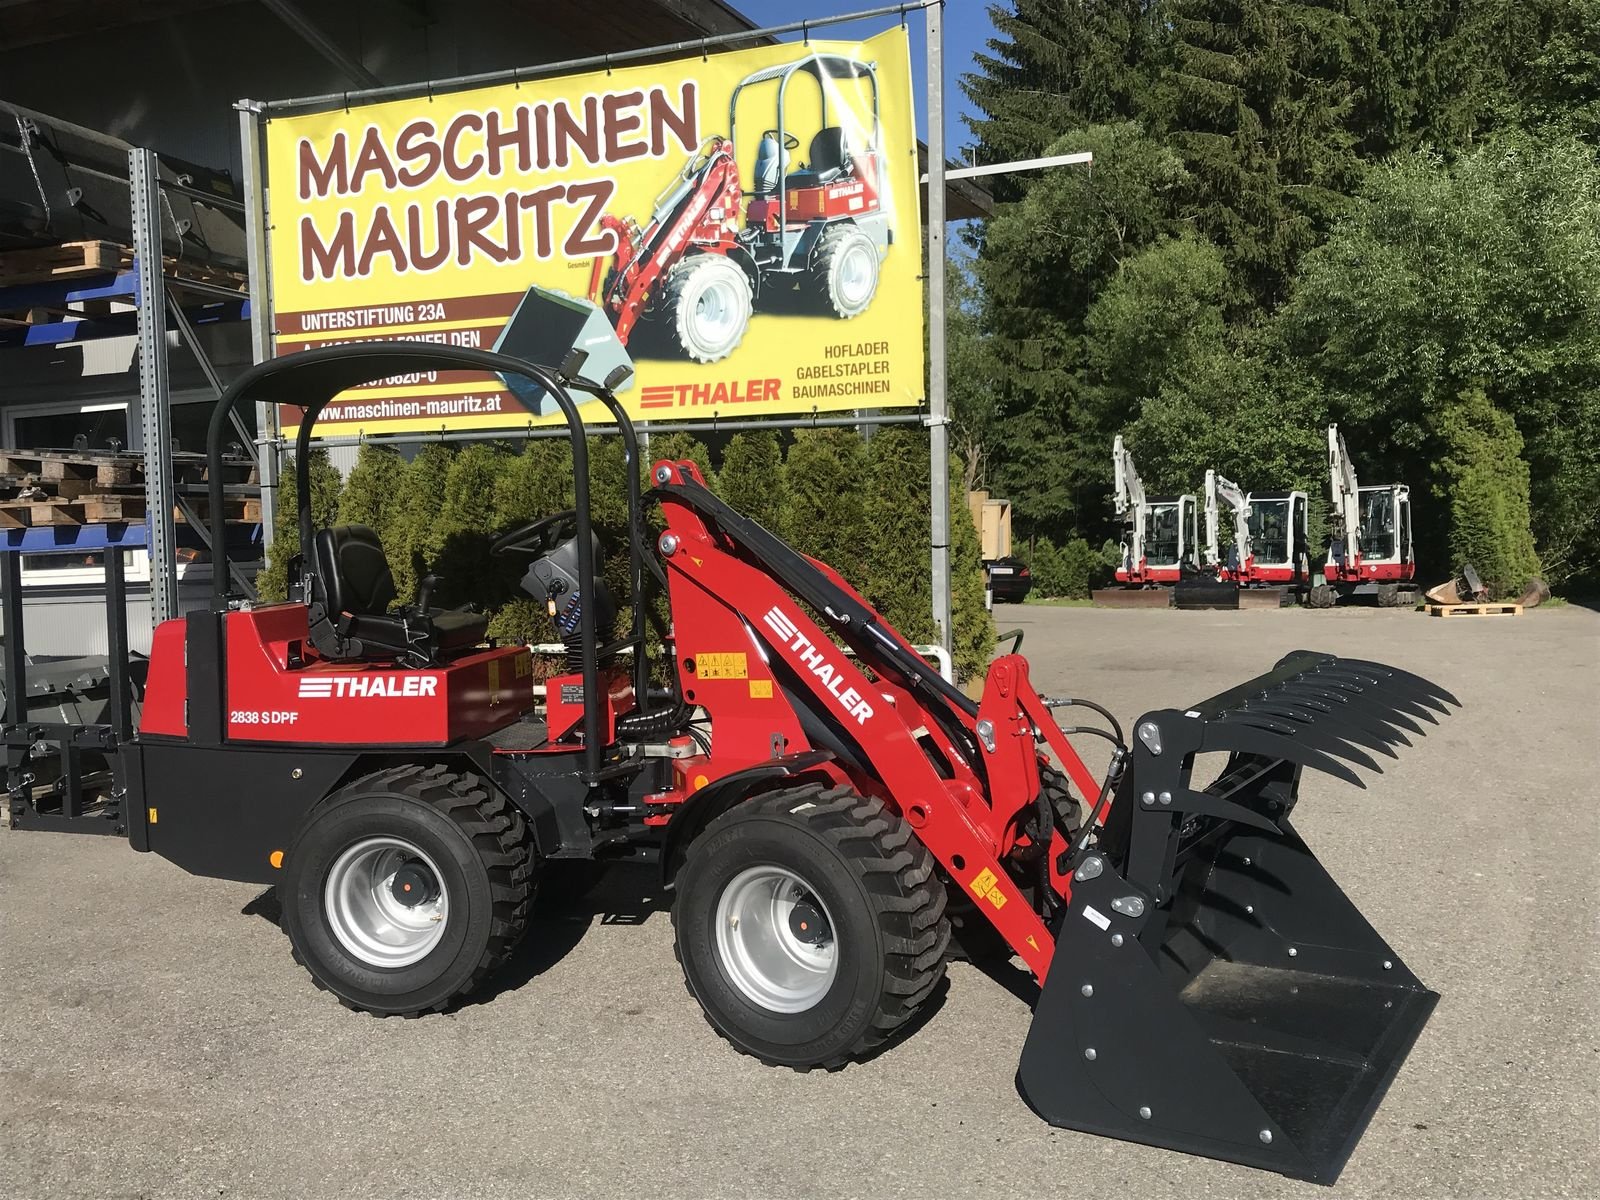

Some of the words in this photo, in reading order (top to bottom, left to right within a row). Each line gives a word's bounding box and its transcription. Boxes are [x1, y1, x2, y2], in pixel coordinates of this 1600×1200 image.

[299, 83, 698, 200] MASCHINEN
[300, 180, 618, 281] MAURITZ
[567, 260, 590, 269] GesmbH
[302, 304, 414, 331] UNTERSTIFTUNG
[418, 303, 446, 321] 23A
[825, 341, 889, 359] HOFLADER
[796, 361, 890, 380] GABELSTAPLER
[675, 379, 781, 406] THALER
[793, 380, 890, 399] BAUMASCHINEN
[306, 392, 501, 421] ww.maschinen-mauritz.at
[333, 677, 437, 698] THALER
[791, 631, 874, 725] THALER
[230, 711, 259, 724] 2838
[261, 712, 270, 724] S
[271, 711, 298, 724] DPF
